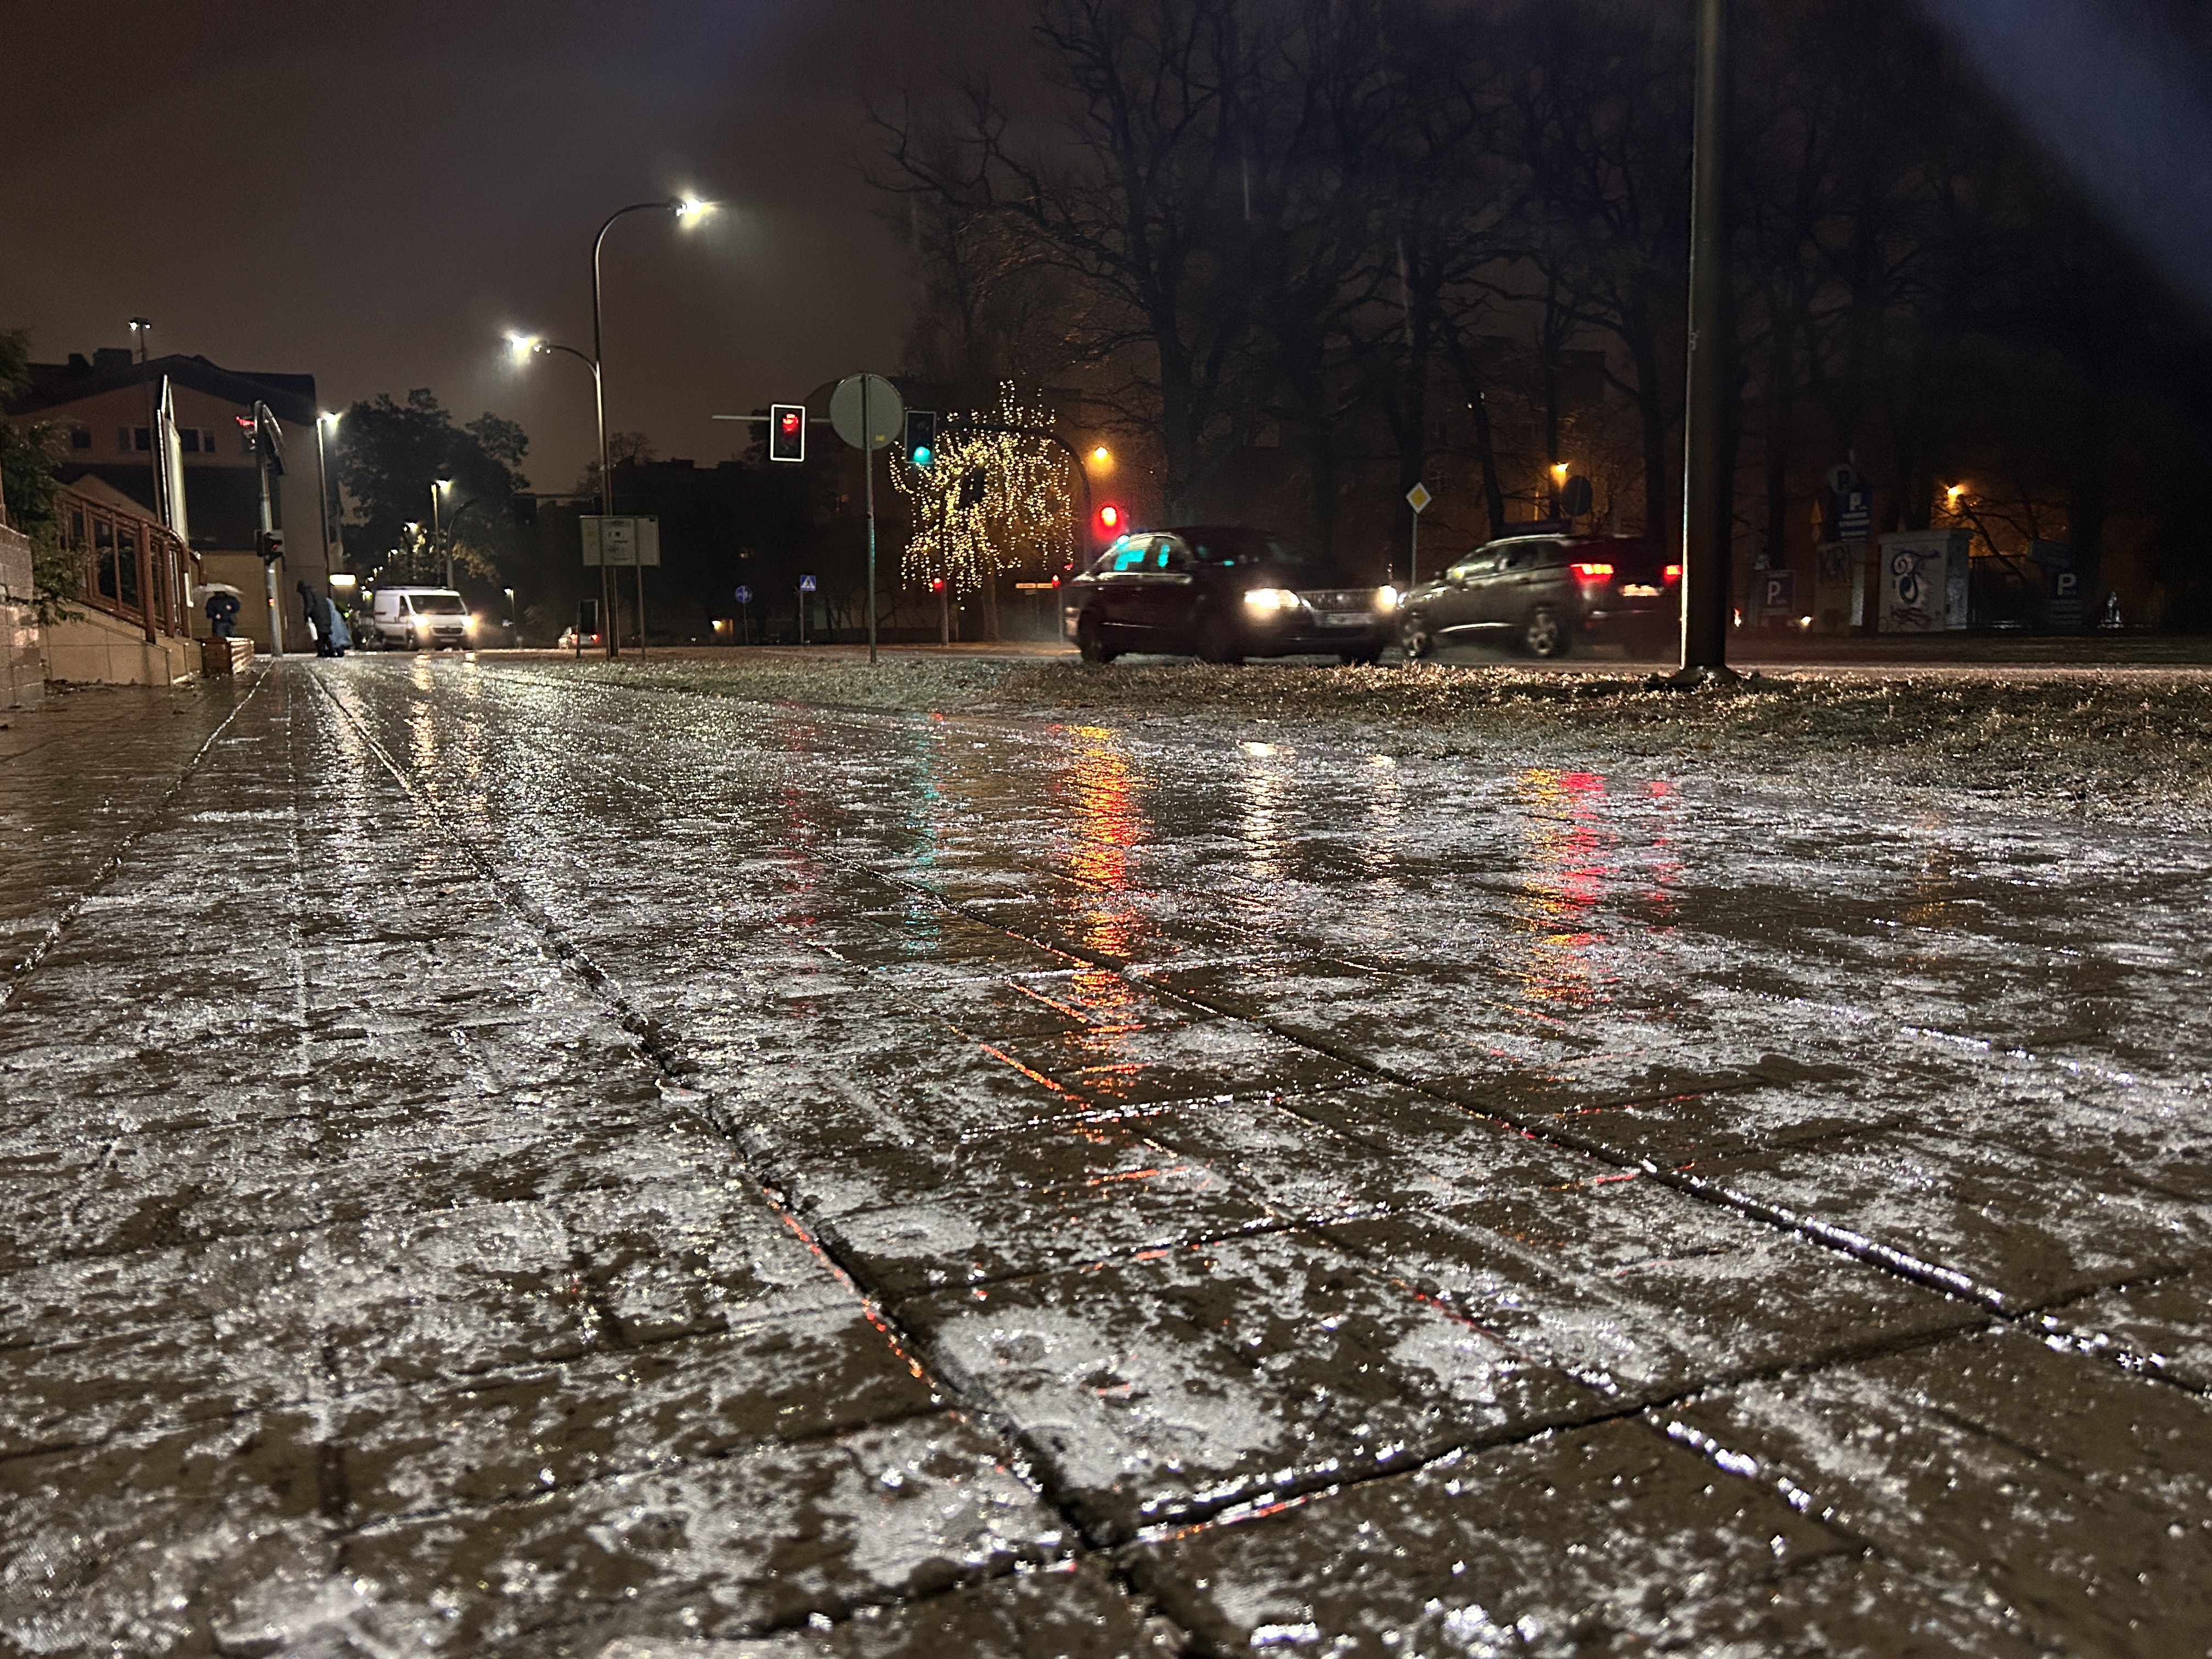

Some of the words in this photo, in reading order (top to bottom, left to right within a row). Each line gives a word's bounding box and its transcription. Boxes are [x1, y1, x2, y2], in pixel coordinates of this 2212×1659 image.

[1849, 492, 1861, 511] P
[1767, 581, 1781, 605] P
[2058, 573, 2076, 595] P
